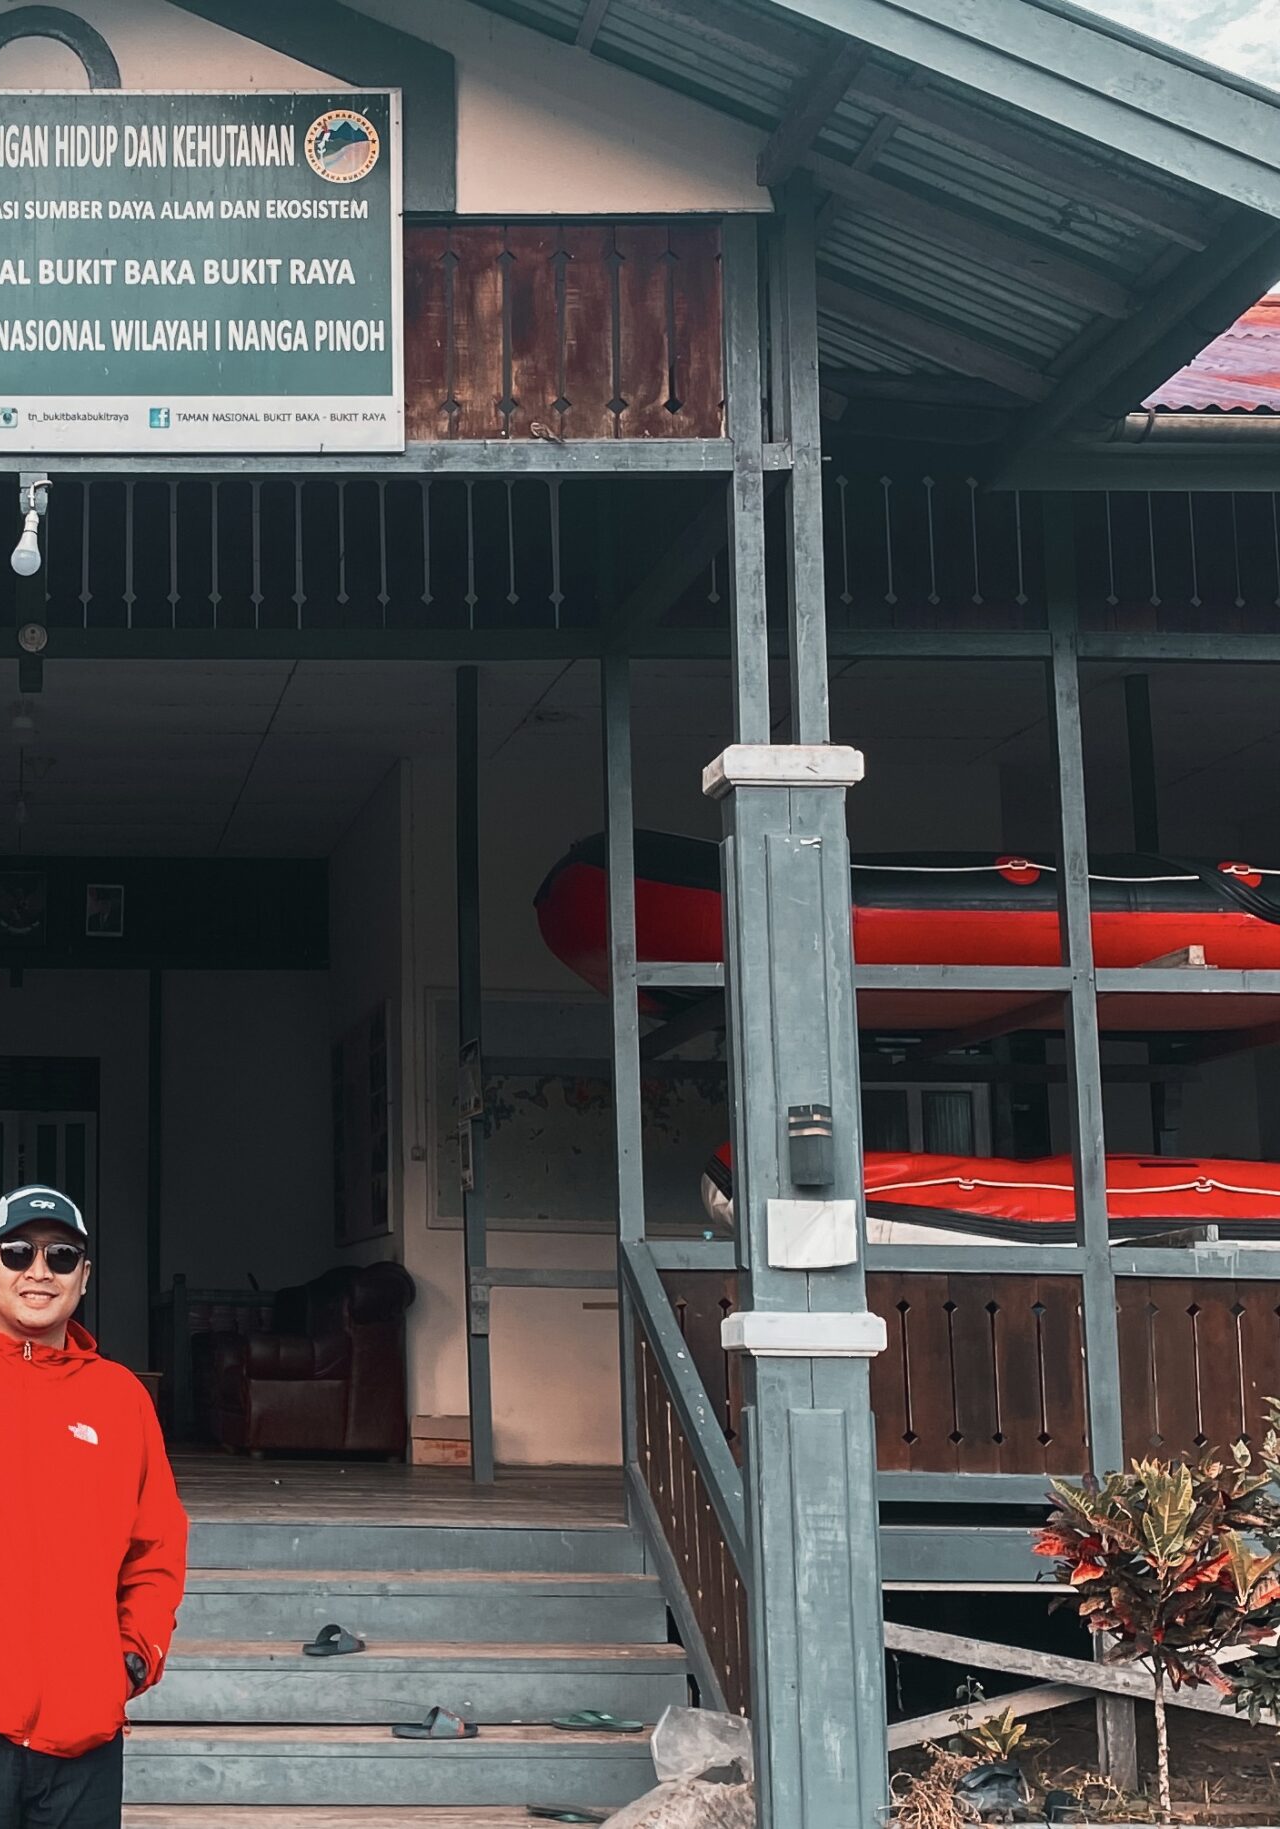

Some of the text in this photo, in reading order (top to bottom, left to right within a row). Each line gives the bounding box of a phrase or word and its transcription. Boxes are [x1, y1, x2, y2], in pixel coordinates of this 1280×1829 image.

[55, 124, 119, 168] HIDUP
[125, 124, 167, 168] DAN
[173, 124, 295, 168] KEHUTANAN
[24, 200, 103, 220] SUMBER
[108, 200, 156, 220] DAYA
[160, 200, 215, 220] ALAM
[220, 199, 260, 219] DAN
[265, 199, 368, 219] EKOSISTEM
[38, 258, 118, 285] BUKIT
[124, 259, 196, 285] BAKA
[203, 259, 283, 285] BUKIT
[289, 259, 356, 285] RAYA
[110, 319, 208, 352] WILAYAH
[214, 319, 221, 352] I
[228, 319, 309, 352] NANGA
[314, 319, 385, 352] PINOH
[27, 412, 130, 423] tn_bukitbakabukitraya
[176, 413, 209, 422] TAMAN
[212, 412, 261, 422] NASIONAL
[263, 412, 293, 422] BUKIT
[295, 413, 320, 422] BAKA
[330, 412, 360, 422] BUKIT
[361, 412, 387, 422] RAYA
